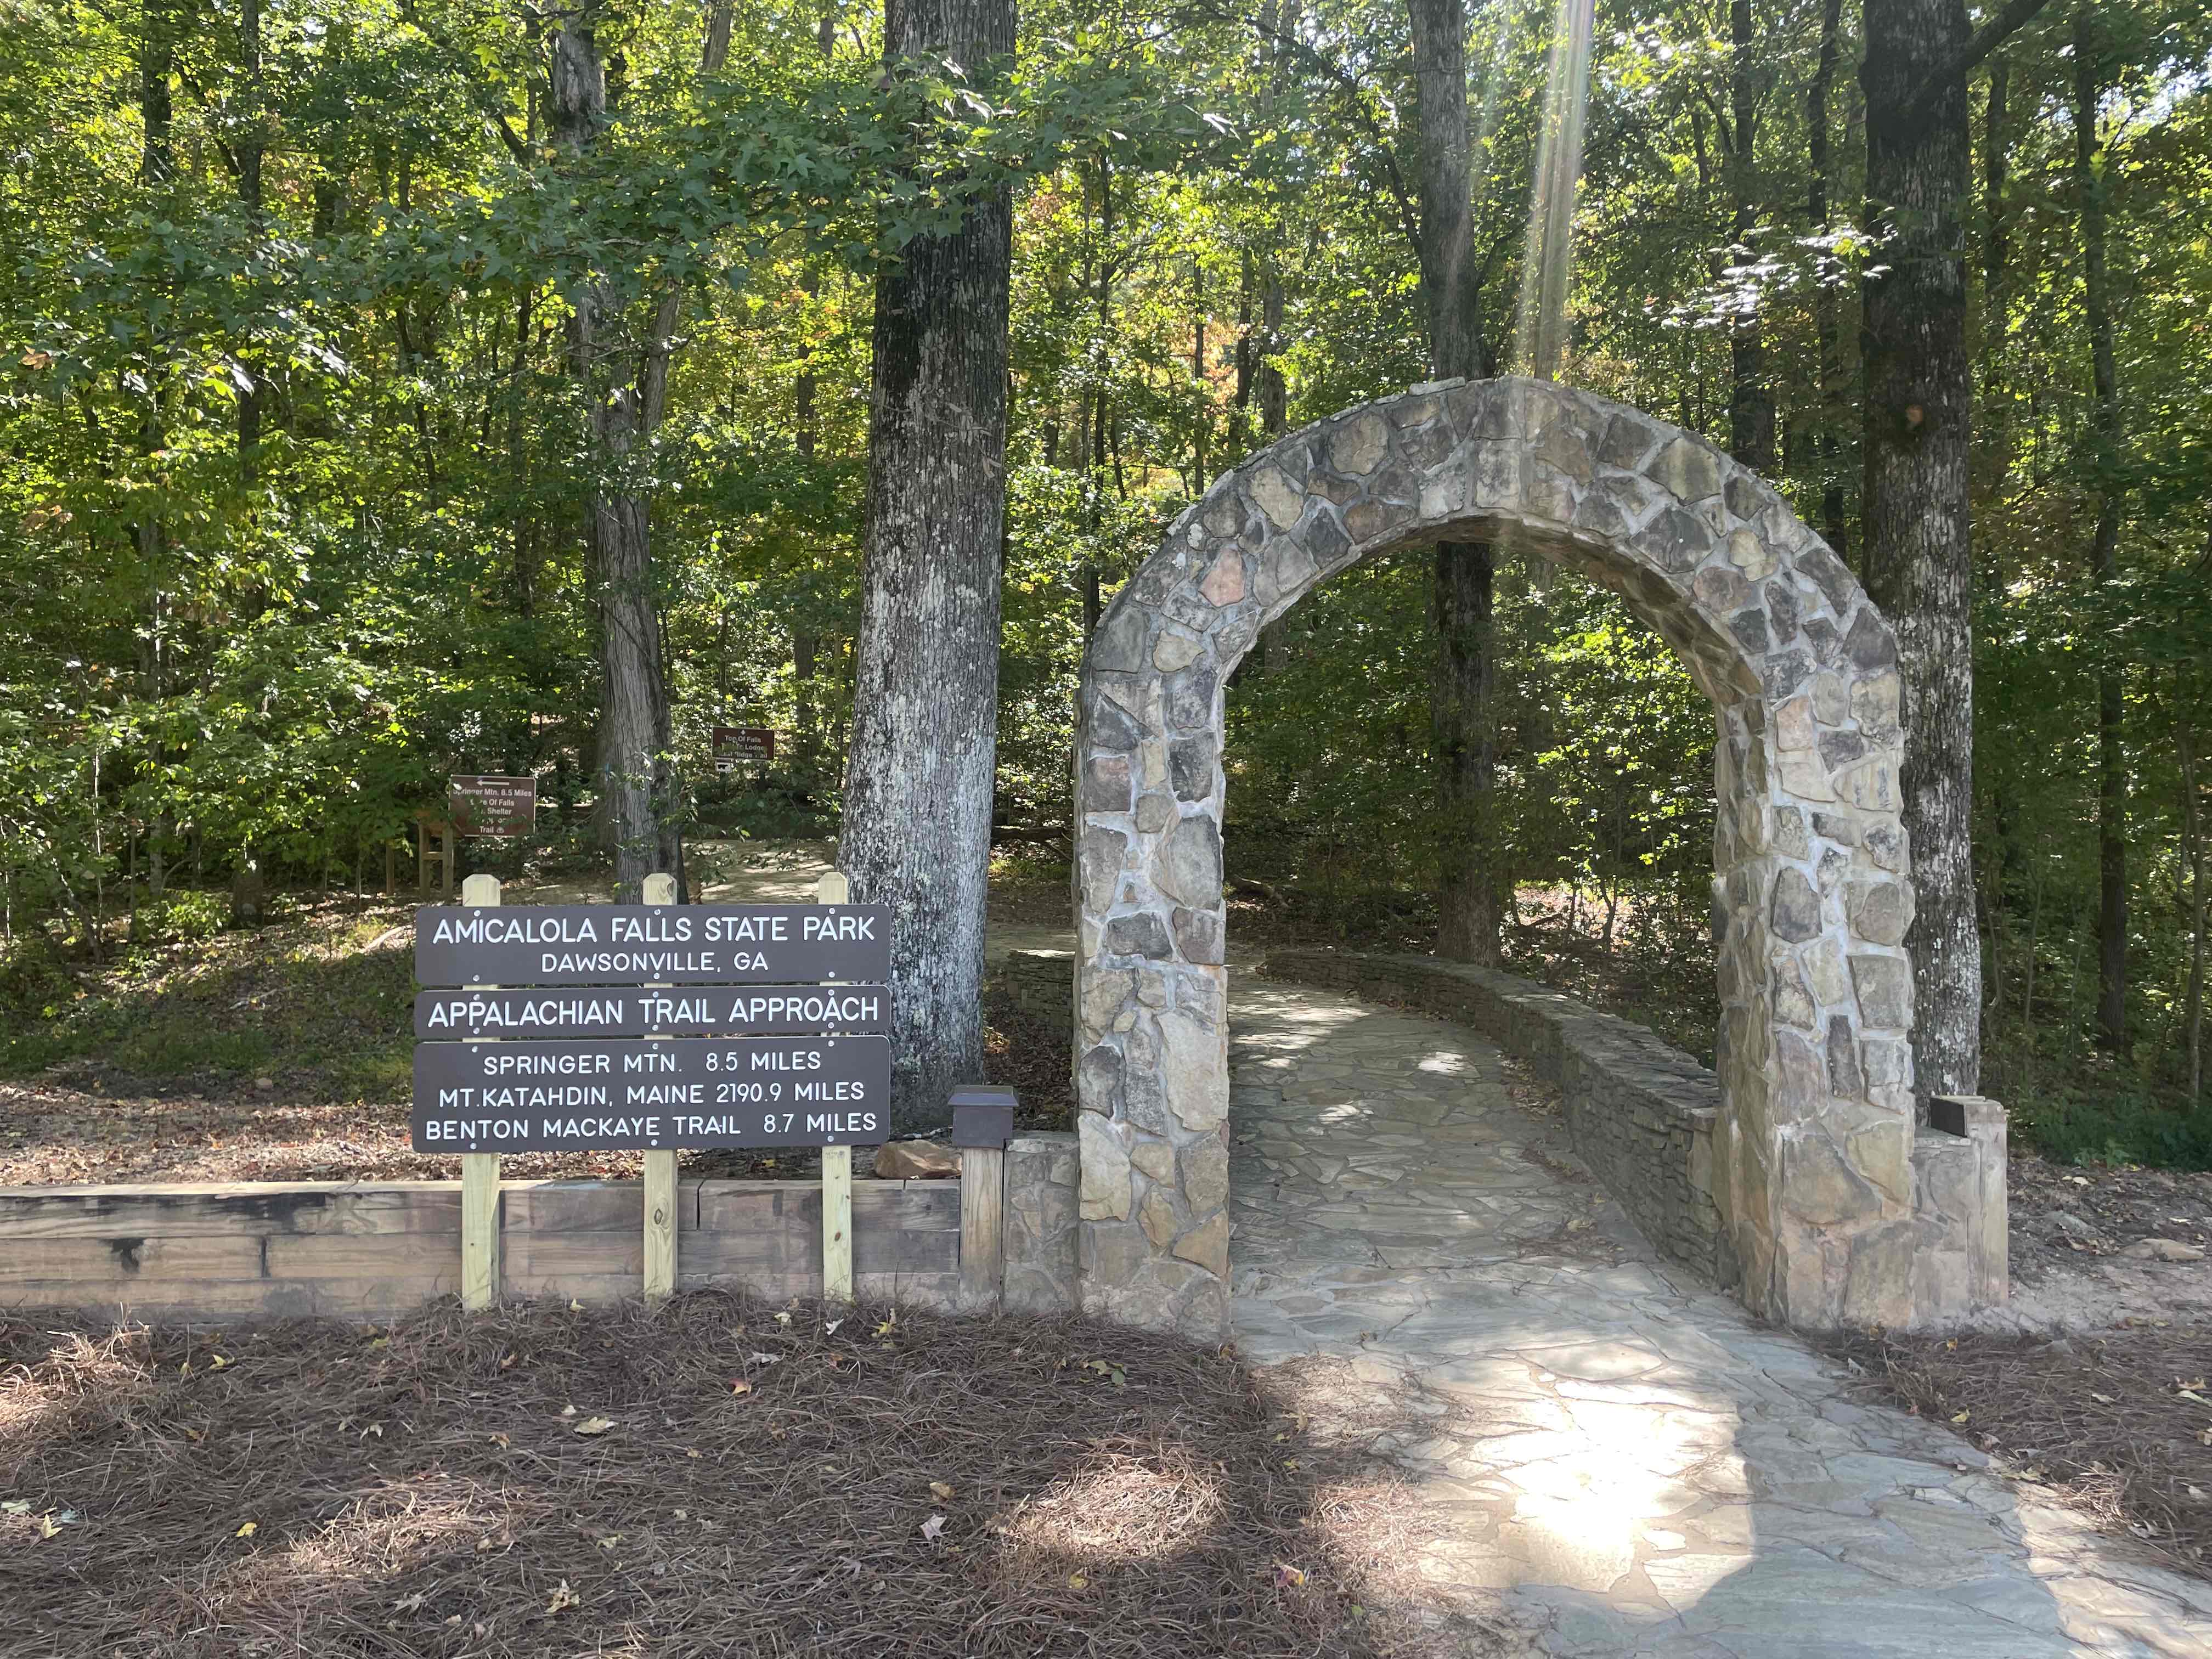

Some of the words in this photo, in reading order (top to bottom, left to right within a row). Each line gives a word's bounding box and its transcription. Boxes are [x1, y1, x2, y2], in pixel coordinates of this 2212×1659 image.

[499, 798, 515, 806] Falls
[514, 789, 532, 797] Miles
[487, 807, 512, 815] Shelter
[432, 917, 597, 944] AMICALOLA
[612, 917, 692, 942] FALLS
[704, 916, 788, 941] STATE
[803, 916, 875, 941] PARK
[541, 952, 720, 973] DAWSONVILLE,
[733, 951, 769, 970] GA
[427, 999, 623, 1028] APPALACHIAN
[637, 998, 716, 1024] TRAIL
[728, 996, 878, 1023] APPROACH
[483, 1054, 610, 1075] SPRINGER
[624, 1053, 682, 1073] MTN.
[706, 1052, 738, 1071] 8.5
[751, 1051, 821, 1071] MILES
[627, 1084, 704, 1104] MAINE
[716, 1082, 782, 1103] 2190.9
[794, 1081, 865, 1101] MILES
[426, 1119, 528, 1140] BENTON
[543, 1116, 660, 1138] MACKAYE
[672, 1115, 741, 1135] TRAIL
[764, 1113, 794, 1133] 8.7
[806, 1113, 877, 1132] MILES
